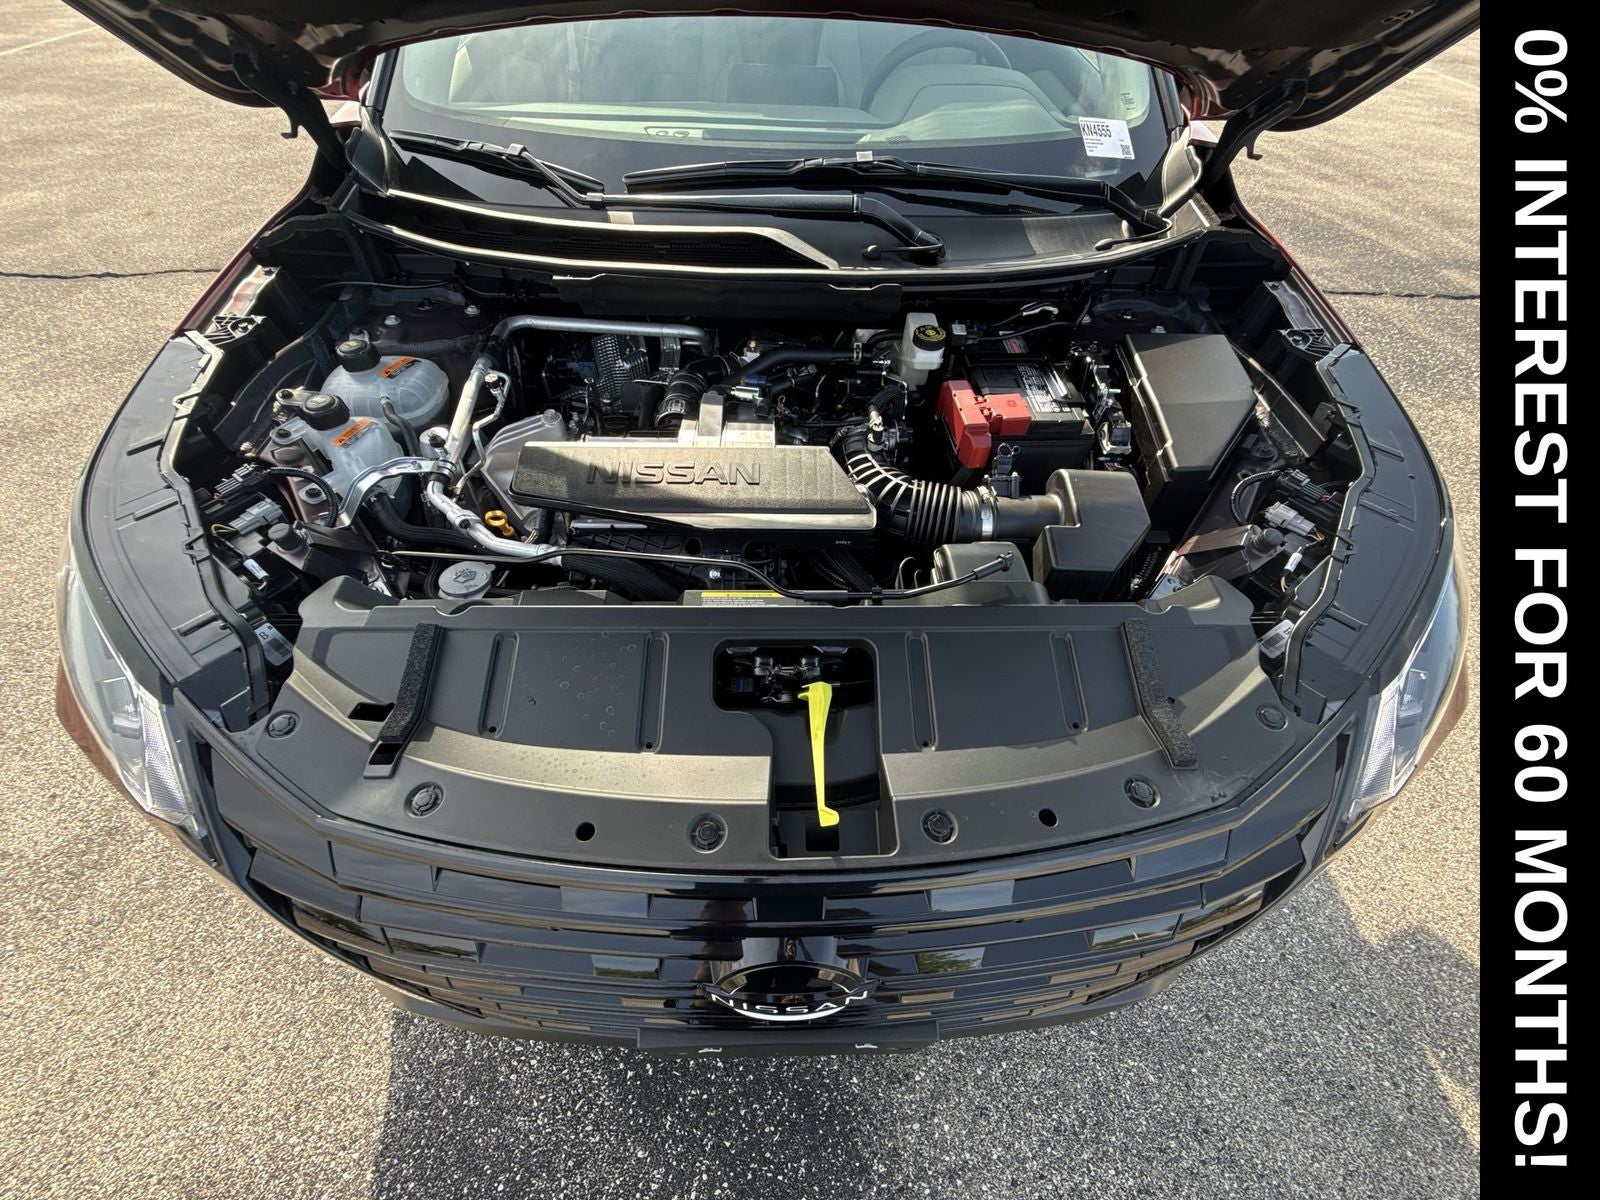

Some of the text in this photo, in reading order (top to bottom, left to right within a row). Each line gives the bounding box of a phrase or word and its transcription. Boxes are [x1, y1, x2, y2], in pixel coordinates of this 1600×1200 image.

[1080, 123, 1112, 138] KN4555
[586, 461, 761, 485] NISSAN
[711, 990, 868, 1014] NISSAN
